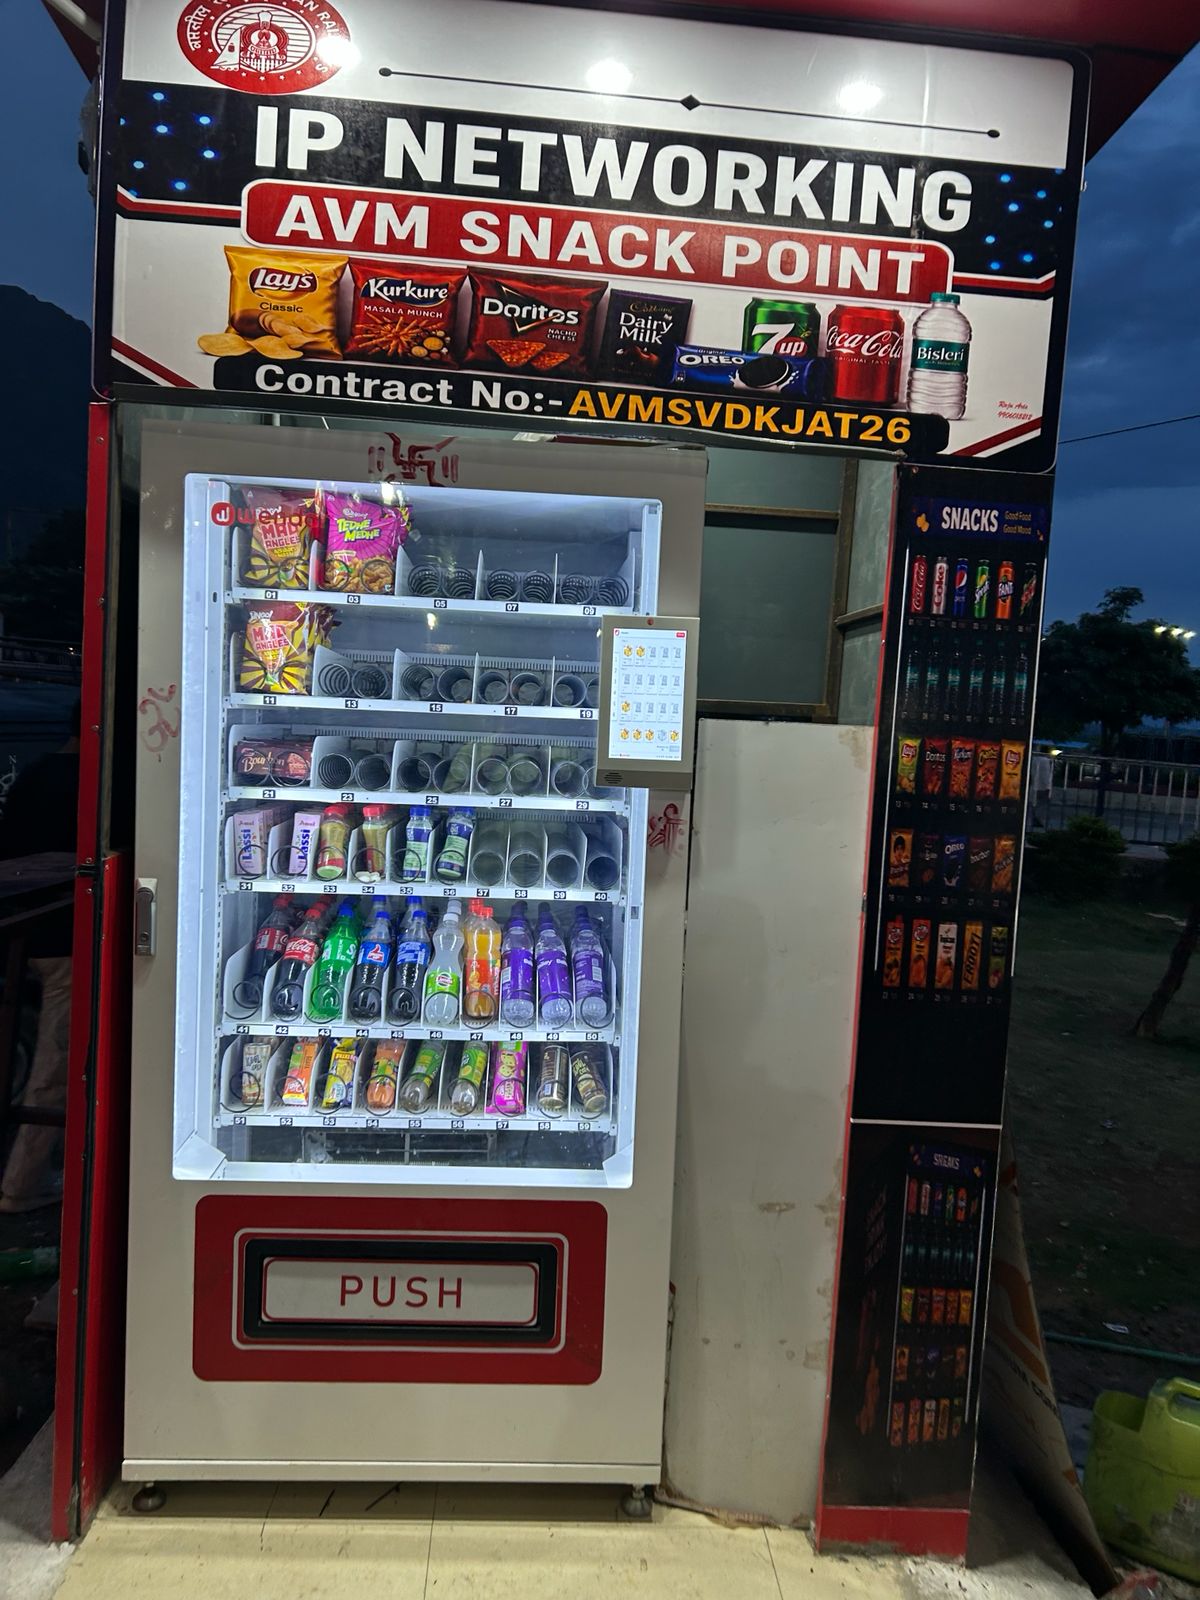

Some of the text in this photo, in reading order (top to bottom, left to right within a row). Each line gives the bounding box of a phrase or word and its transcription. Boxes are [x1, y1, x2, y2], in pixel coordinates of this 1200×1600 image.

[254, 105, 973, 232] IP NETWORKING
[275, 194, 926, 295] AVM SNACK POINT
[253, 268, 314, 291] Lay's
[369, 277, 449, 302] Kurkure
[259, 301, 303, 313] Classic
[364, 304, 443, 319] MASALA MUNCH
[483, 297, 580, 325] Doritos
[619, 311, 673, 334] Dairy
[548, 327, 577, 337] NACHO
[619, 326, 663, 345] Milk
[547, 333, 577, 342] CHEESE
[917, 346, 965, 361] Bisleri
[679, 354, 745, 365] OREO
[255, 364, 453, 405] Contract
[568, 390, 912, 444] AVMSVDKJAT26
[941, 505, 1000, 533] SNACKS
[435, 600, 446, 608] 05
[584, 607, 595, 615] 09
[346, 700, 357, 708] 13
[431, 704, 441, 712] 15
[581, 710, 592, 718] 19
[264, 790, 275, 798] 21
[577, 801, 588, 809] 29
[241, 828, 253, 860] Lassi
[298, 829, 310, 860] Lassi
[240, 882, 252, 890] 31
[283, 884, 294, 892] 32
[325, 885, 337, 893] 33
[362, 886, 375, 894] 34
[478, 888, 489, 896] 37
[554, 891, 566, 899] 39
[595, 893, 607, 901] 40
[235, 1117, 246, 1125] 51
[340, 1275, 463, 1309] PUSH
